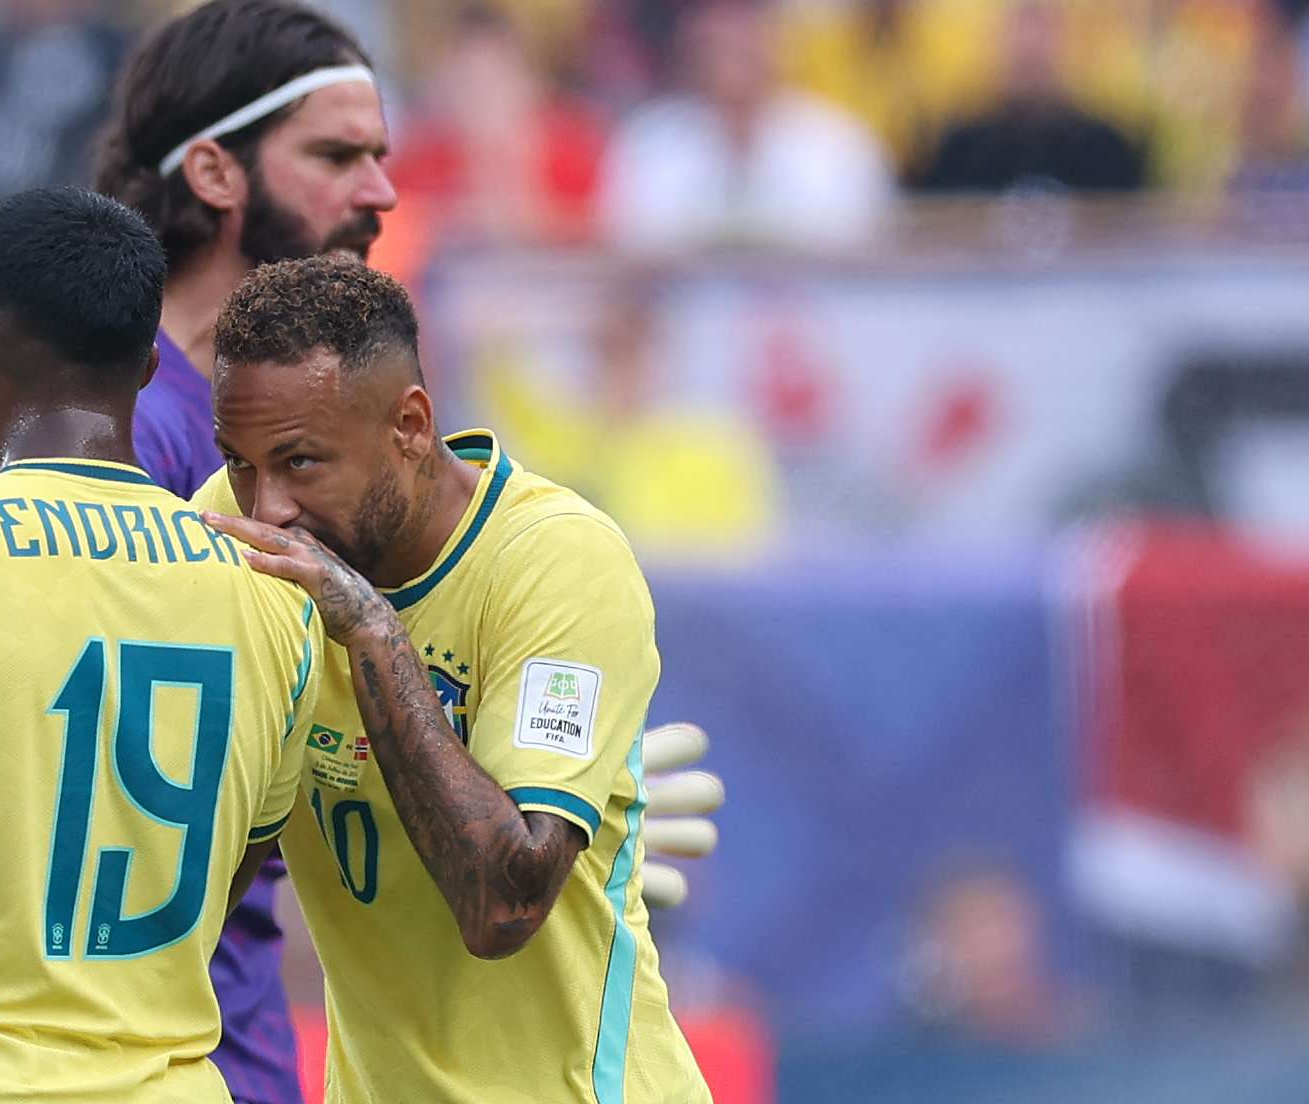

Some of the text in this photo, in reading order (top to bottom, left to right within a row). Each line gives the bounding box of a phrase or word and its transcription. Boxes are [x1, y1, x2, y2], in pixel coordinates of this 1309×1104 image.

[530, 716, 582, 738] EDUCATION
[545, 732, 565, 744] FIFA
[45, 636, 236, 961] 19
[311, 787, 380, 905] 10
